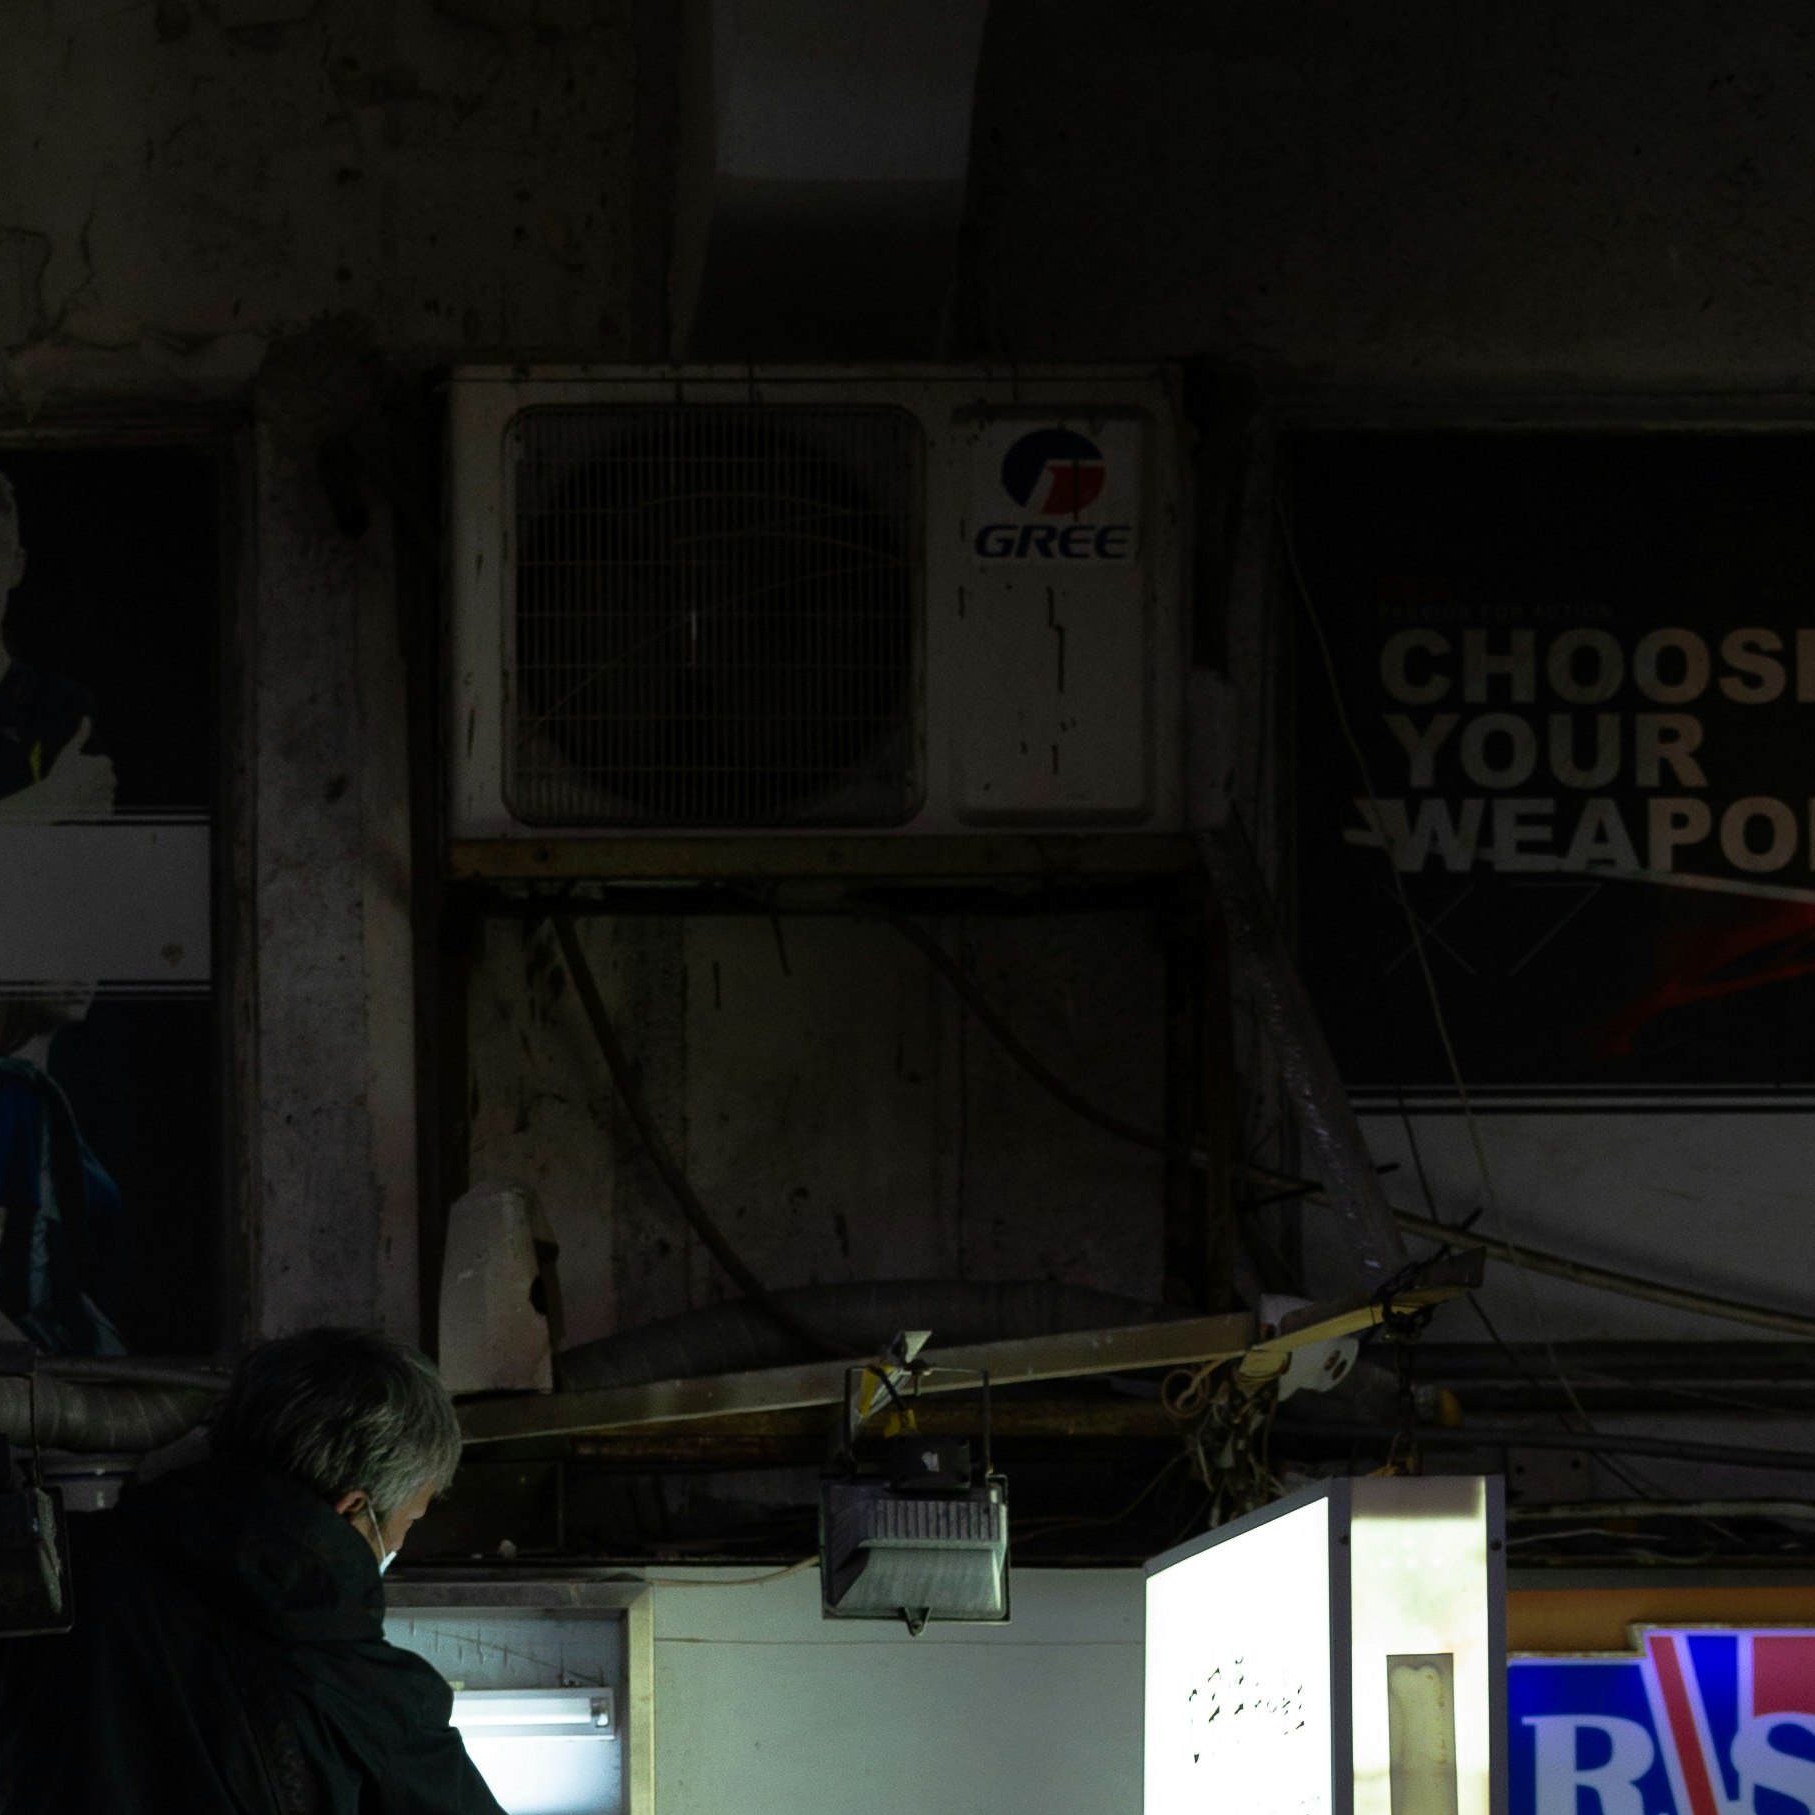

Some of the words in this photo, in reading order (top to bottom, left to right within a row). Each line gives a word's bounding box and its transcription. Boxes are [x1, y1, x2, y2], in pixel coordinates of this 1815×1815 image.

[975, 524, 1131, 559] GREE
[1382, 712, 1709, 788] YOUR
[1351, 796, 1815, 874] WEAPO
